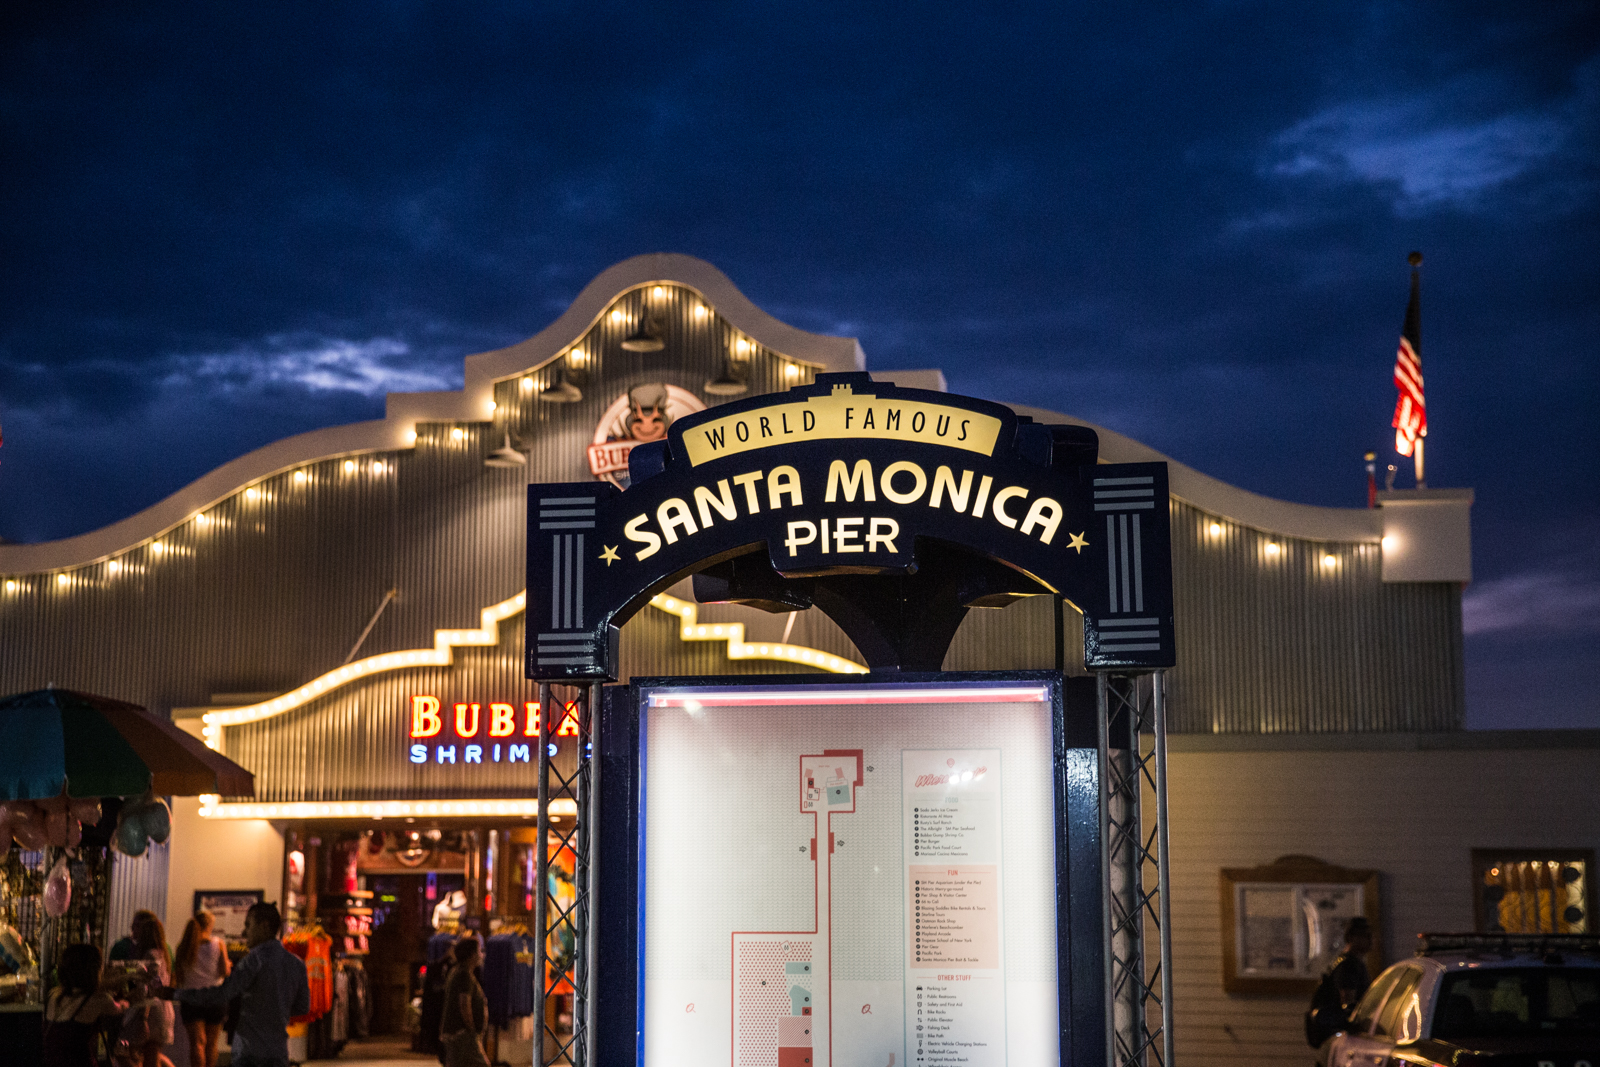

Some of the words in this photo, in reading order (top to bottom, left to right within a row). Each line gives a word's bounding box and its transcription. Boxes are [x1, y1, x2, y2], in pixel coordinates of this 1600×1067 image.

[704, 409, 816, 452] WORLD
[845, 407, 972, 442] FAMOUS
[623, 464, 804, 562] SANTA
[824, 459, 1064, 545] MONICA
[784, 517, 900, 557] PIER
